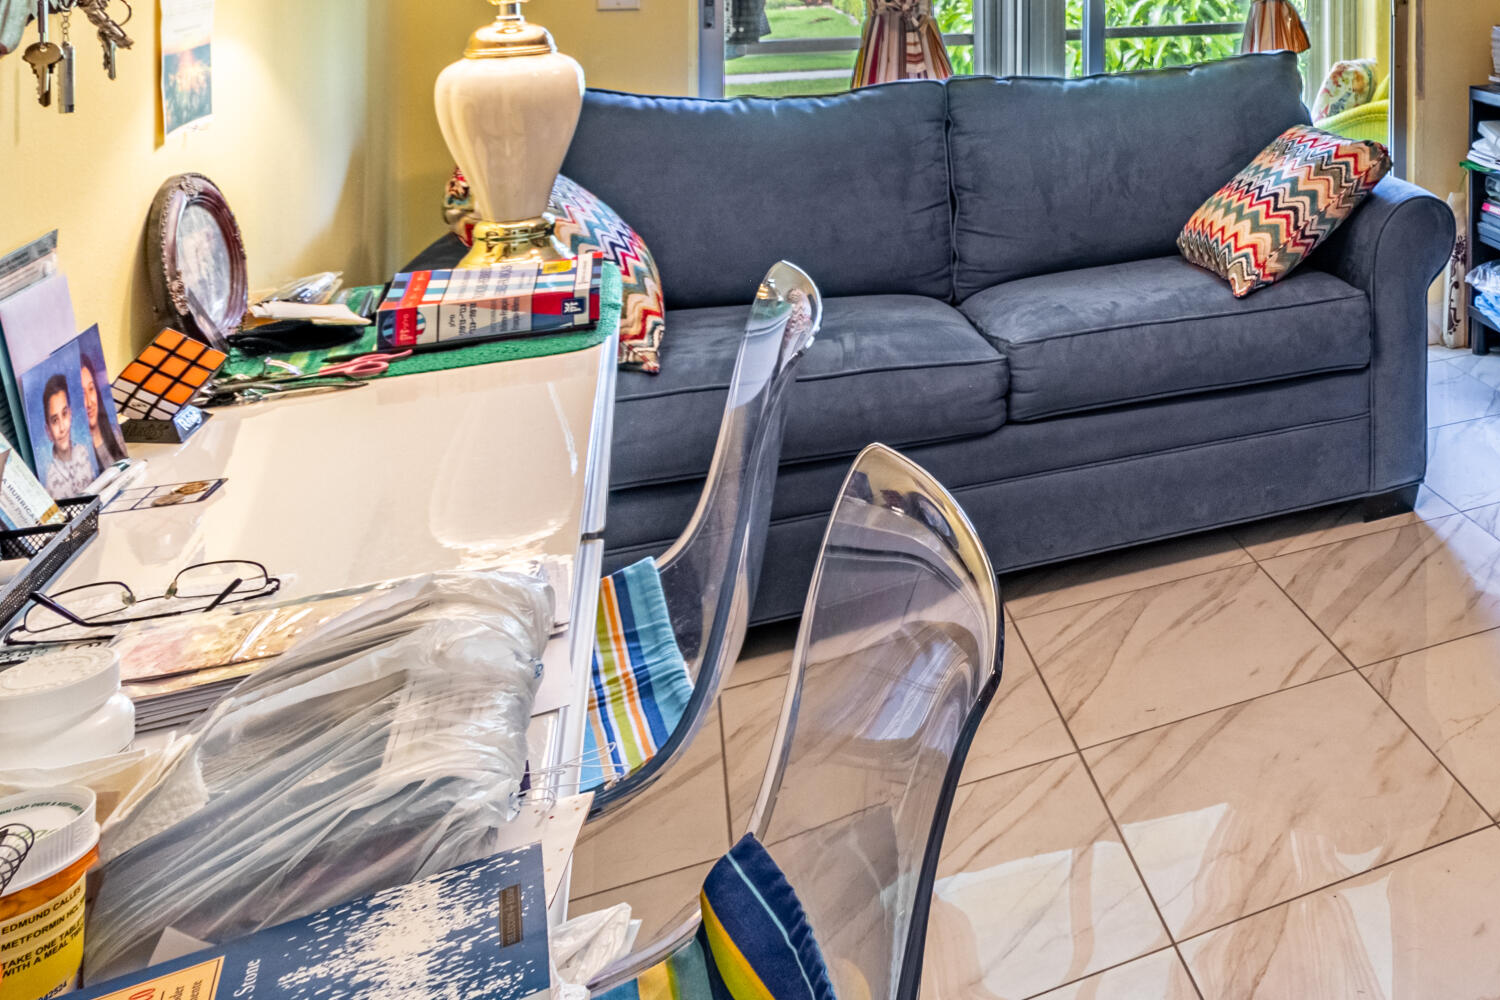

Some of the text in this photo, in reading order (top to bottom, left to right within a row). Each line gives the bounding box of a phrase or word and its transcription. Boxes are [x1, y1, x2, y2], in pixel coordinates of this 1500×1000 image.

[0, 915, 65, 952] METFORMIN
[1, 907, 51, 936] EDMUND
[1, 951, 33, 970] TAKE
[35, 939, 57, 955] ONE
[1, 961, 31, 980] WITH
[33, 956, 41, 966] A
[44, 939, 69, 960] MEAL
[233, 957, 261, 999] Stone
